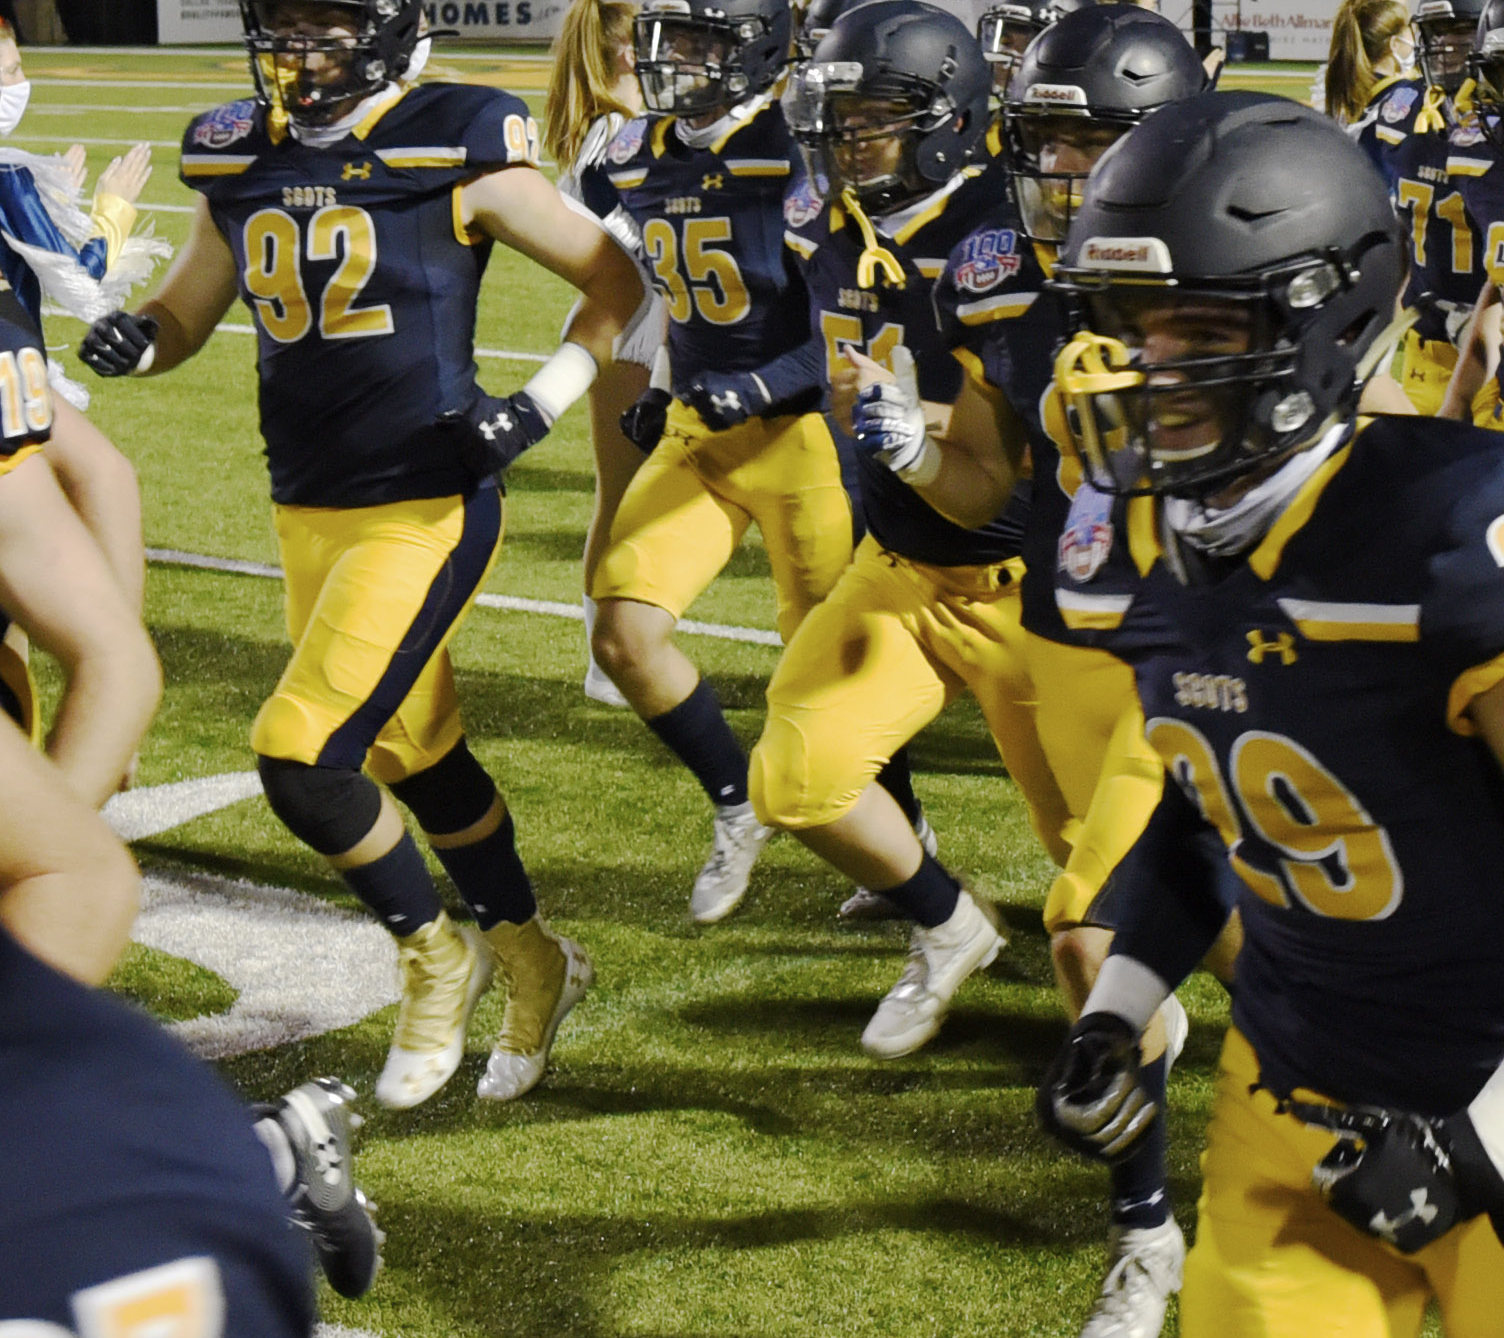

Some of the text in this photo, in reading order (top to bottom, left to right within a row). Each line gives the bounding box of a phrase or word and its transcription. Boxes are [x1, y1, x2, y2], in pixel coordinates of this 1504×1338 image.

[281, 185, 337, 208] SCOTS
[1397, 178, 1473, 274] 71
[242, 203, 394, 345] 92
[642, 216, 751, 326] 35
[965, 228, 1017, 260] 100
[1172, 670, 1249, 714] SCOTS
